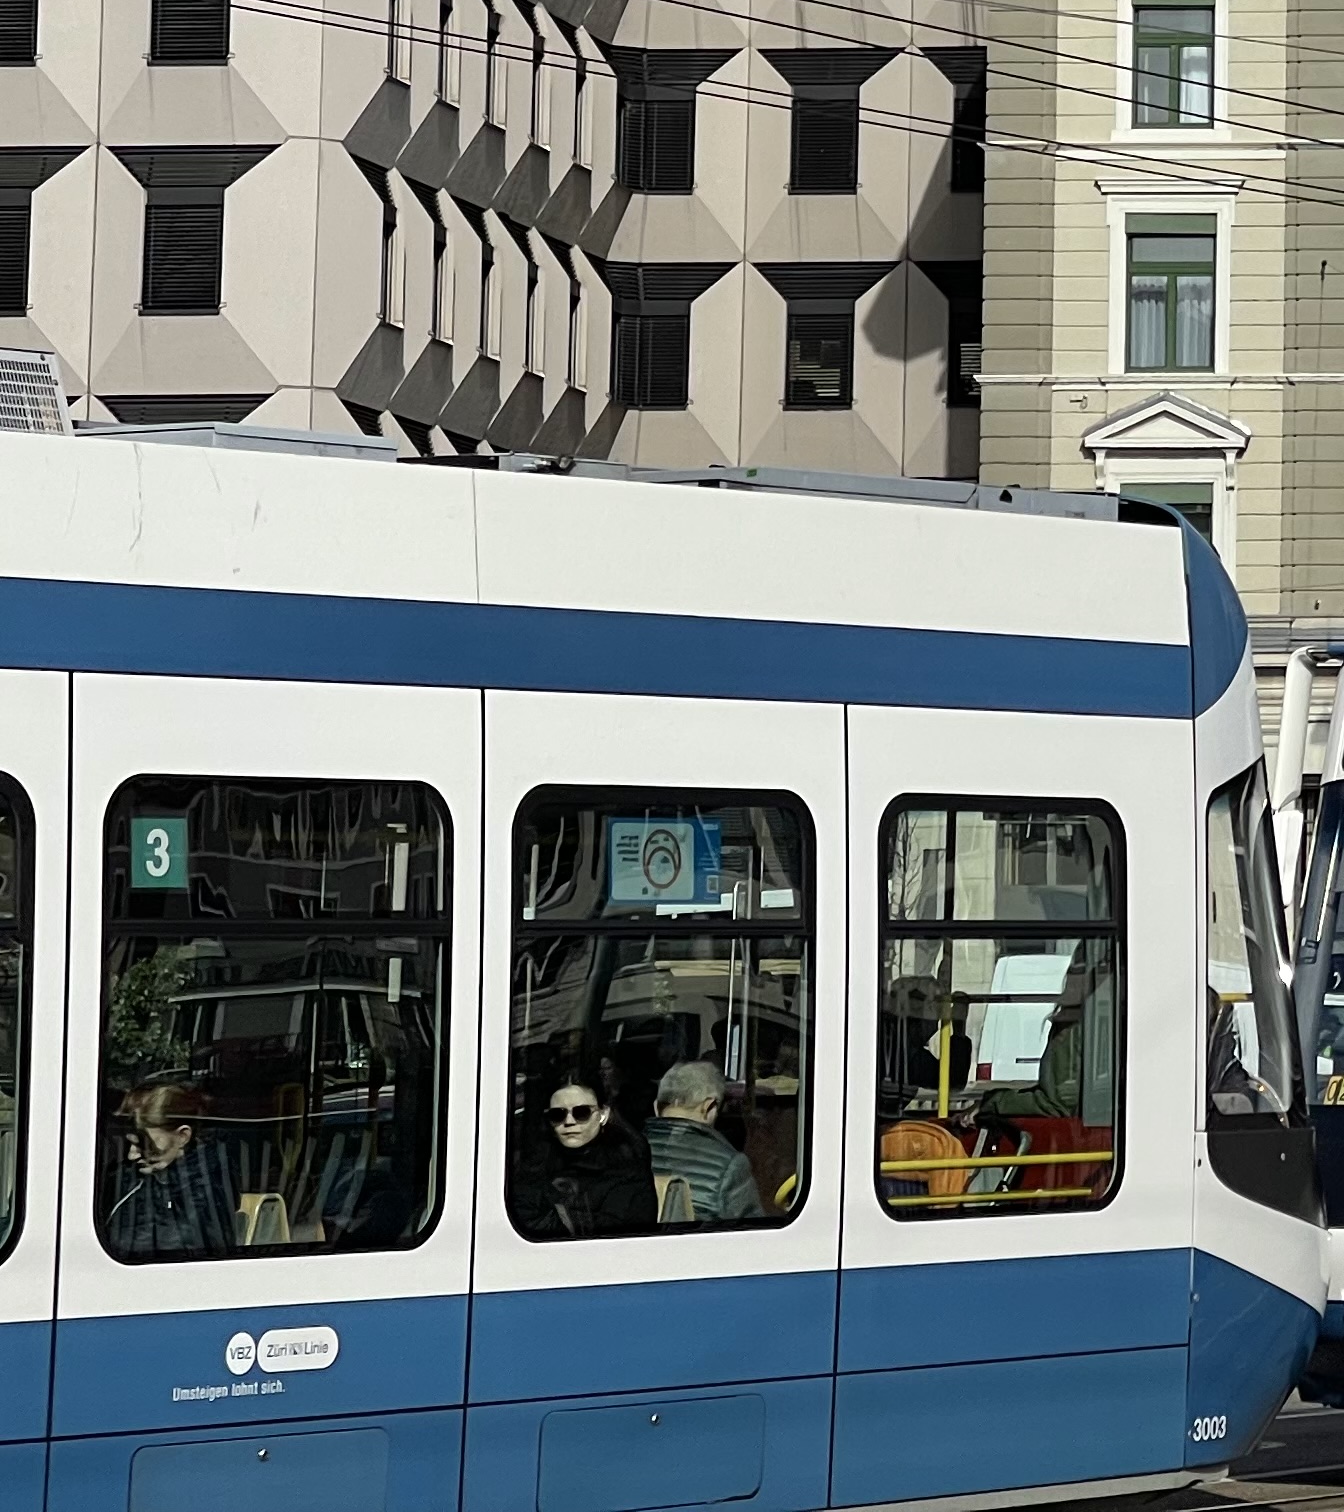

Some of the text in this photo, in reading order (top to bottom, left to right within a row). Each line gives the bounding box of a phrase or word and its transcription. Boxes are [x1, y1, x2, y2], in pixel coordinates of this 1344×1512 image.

[145, 828, 171, 877] 3
[229, 1345, 253, 1360] VBZ
[1192, 1415, 1227, 1442] 3003
